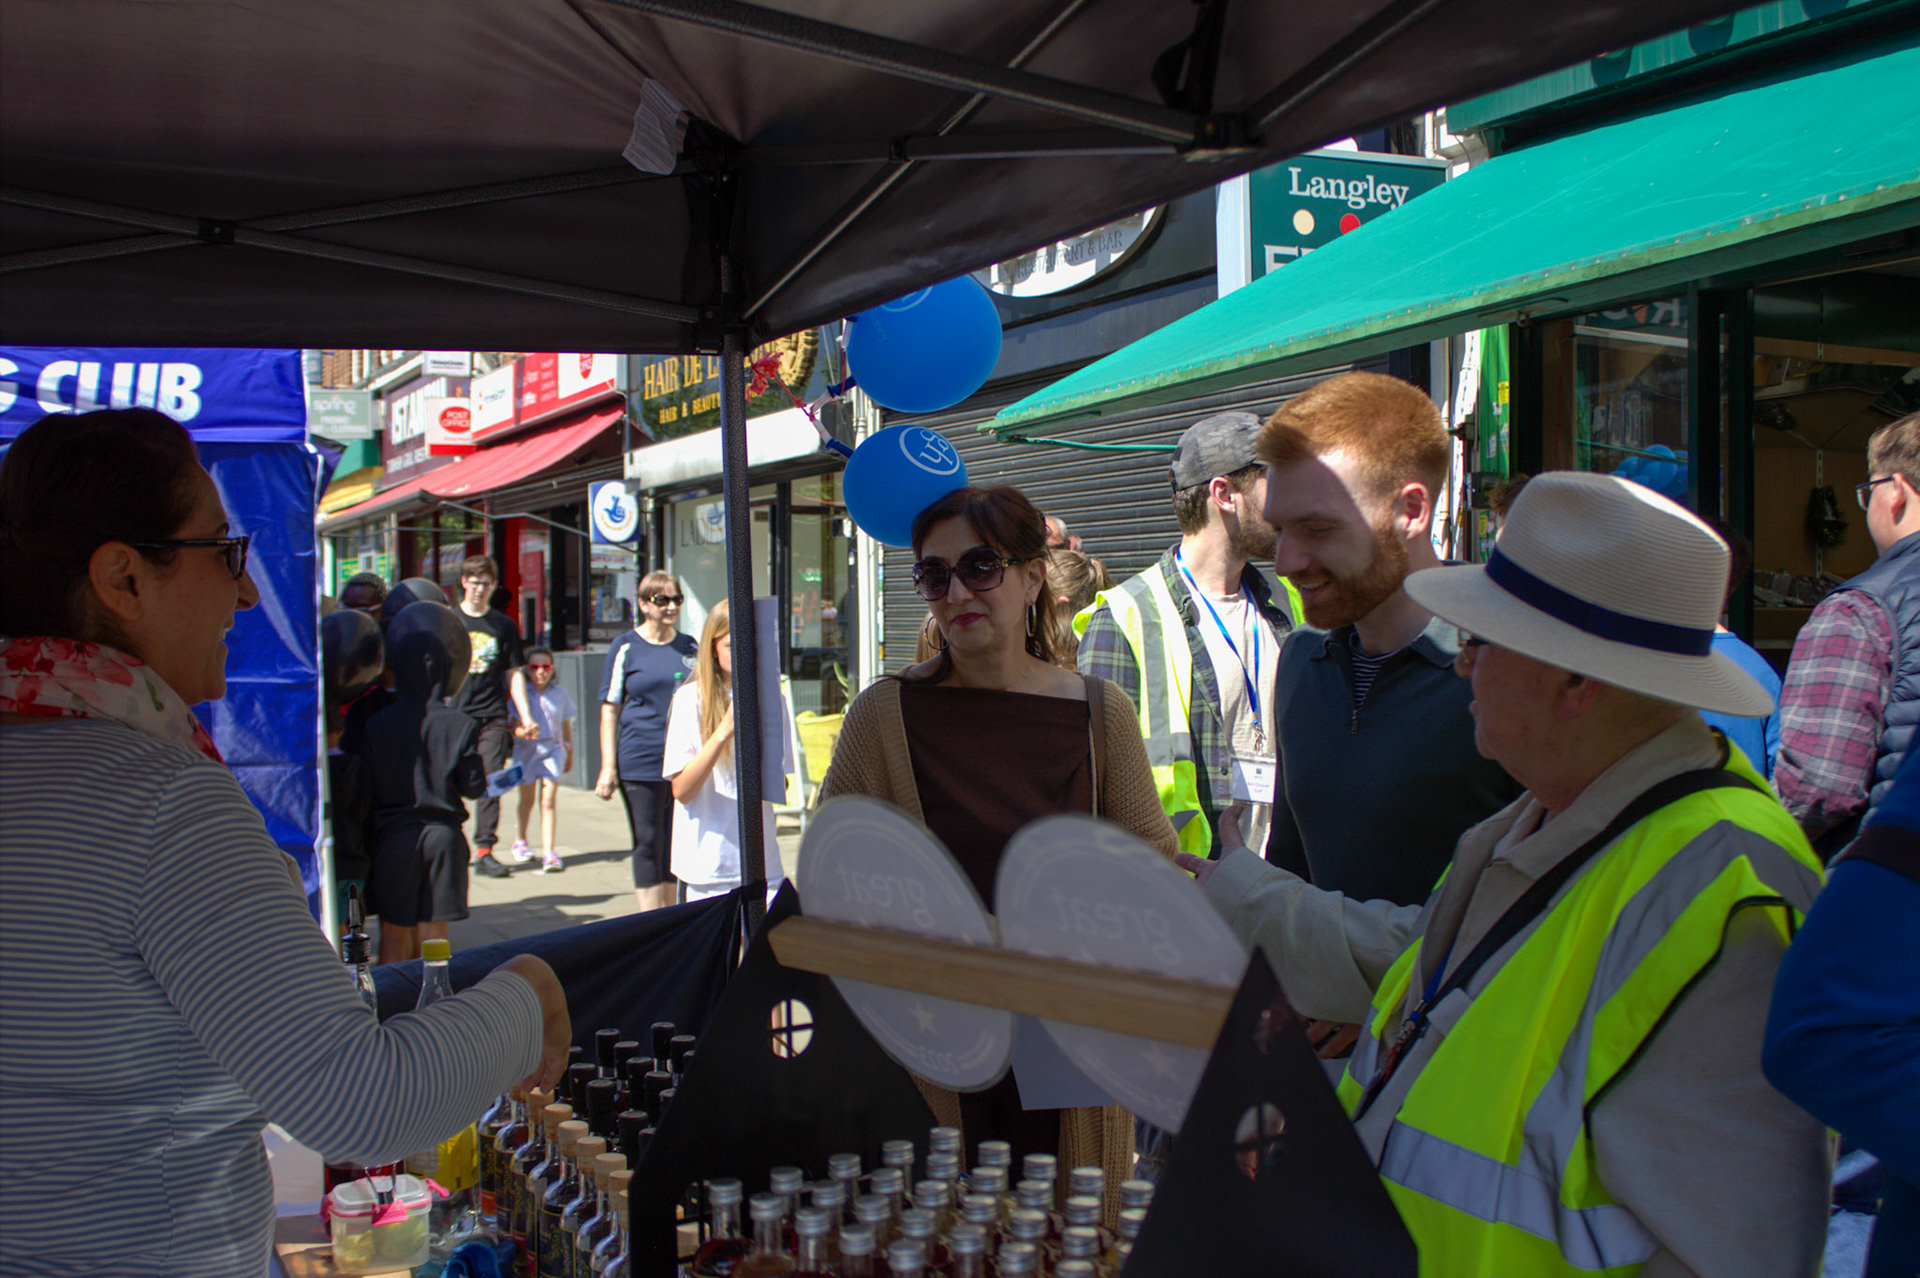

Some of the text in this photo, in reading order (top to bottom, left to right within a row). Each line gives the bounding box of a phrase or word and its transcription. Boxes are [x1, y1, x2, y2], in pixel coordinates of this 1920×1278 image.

[1288, 166, 1410, 211] Langley
[1016, 243, 1086, 279] RESTAURANT
[1098, 229, 1123, 254] BAR
[36, 360, 204, 422] CLUB
[643, 356, 679, 400] HAIR
[683, 355, 703, 387] DE
[446, 411, 469, 420] POST
[659, 406, 678, 425] HAIR
[681, 401, 688, 418] &
